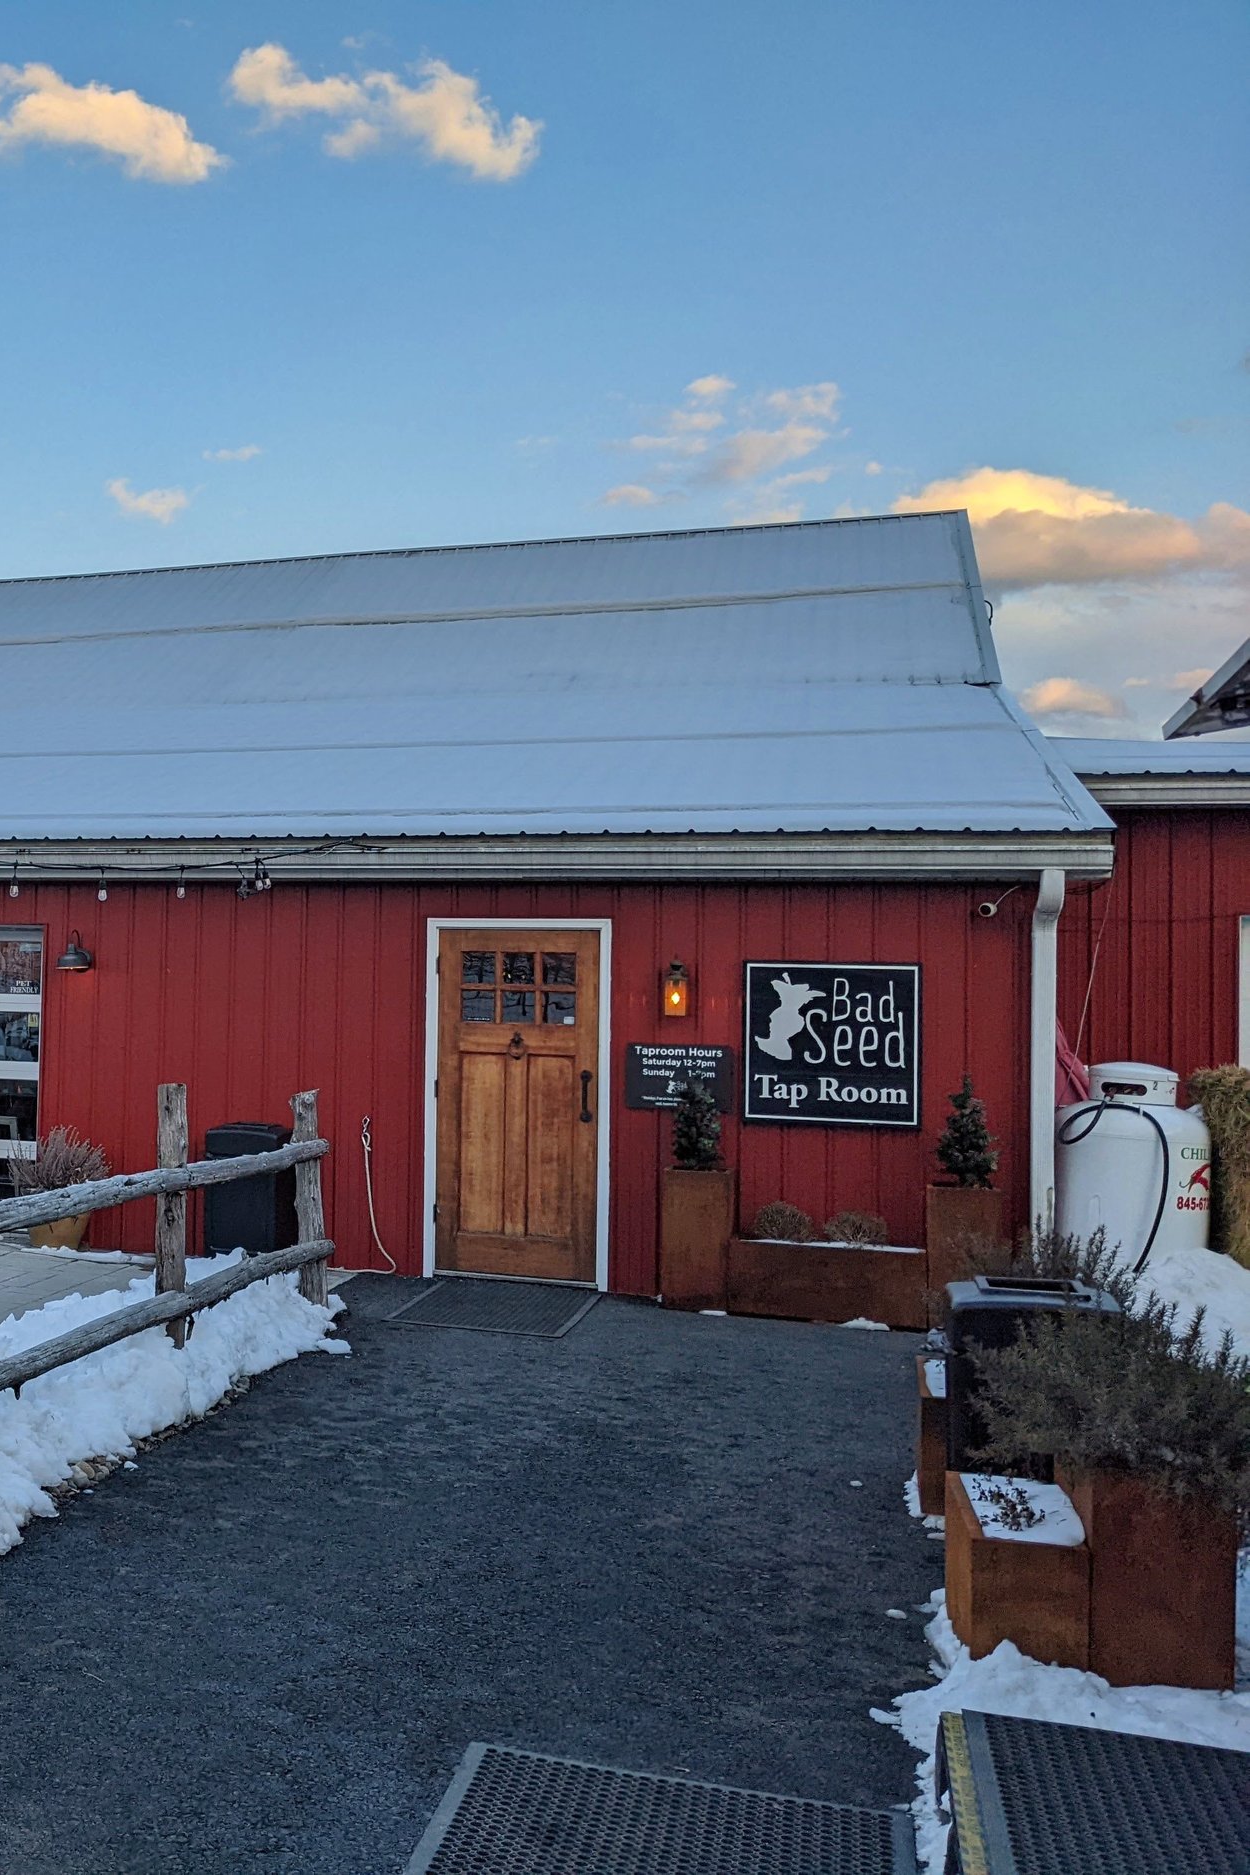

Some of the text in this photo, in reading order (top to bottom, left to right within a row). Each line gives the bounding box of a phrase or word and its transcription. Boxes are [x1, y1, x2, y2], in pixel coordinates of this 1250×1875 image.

[831, 977, 895, 1023] Bad
[803, 1008, 906, 1068] Seed
[634, 1045, 723, 1058] Taproom Hours
[642, 1058, 716, 1069] Saturday 12-7pm
[642, 1068, 675, 1078] Sunday
[753, 1074, 909, 1109] Tap Room
[1152, 1080, 1158, 1091] 2
